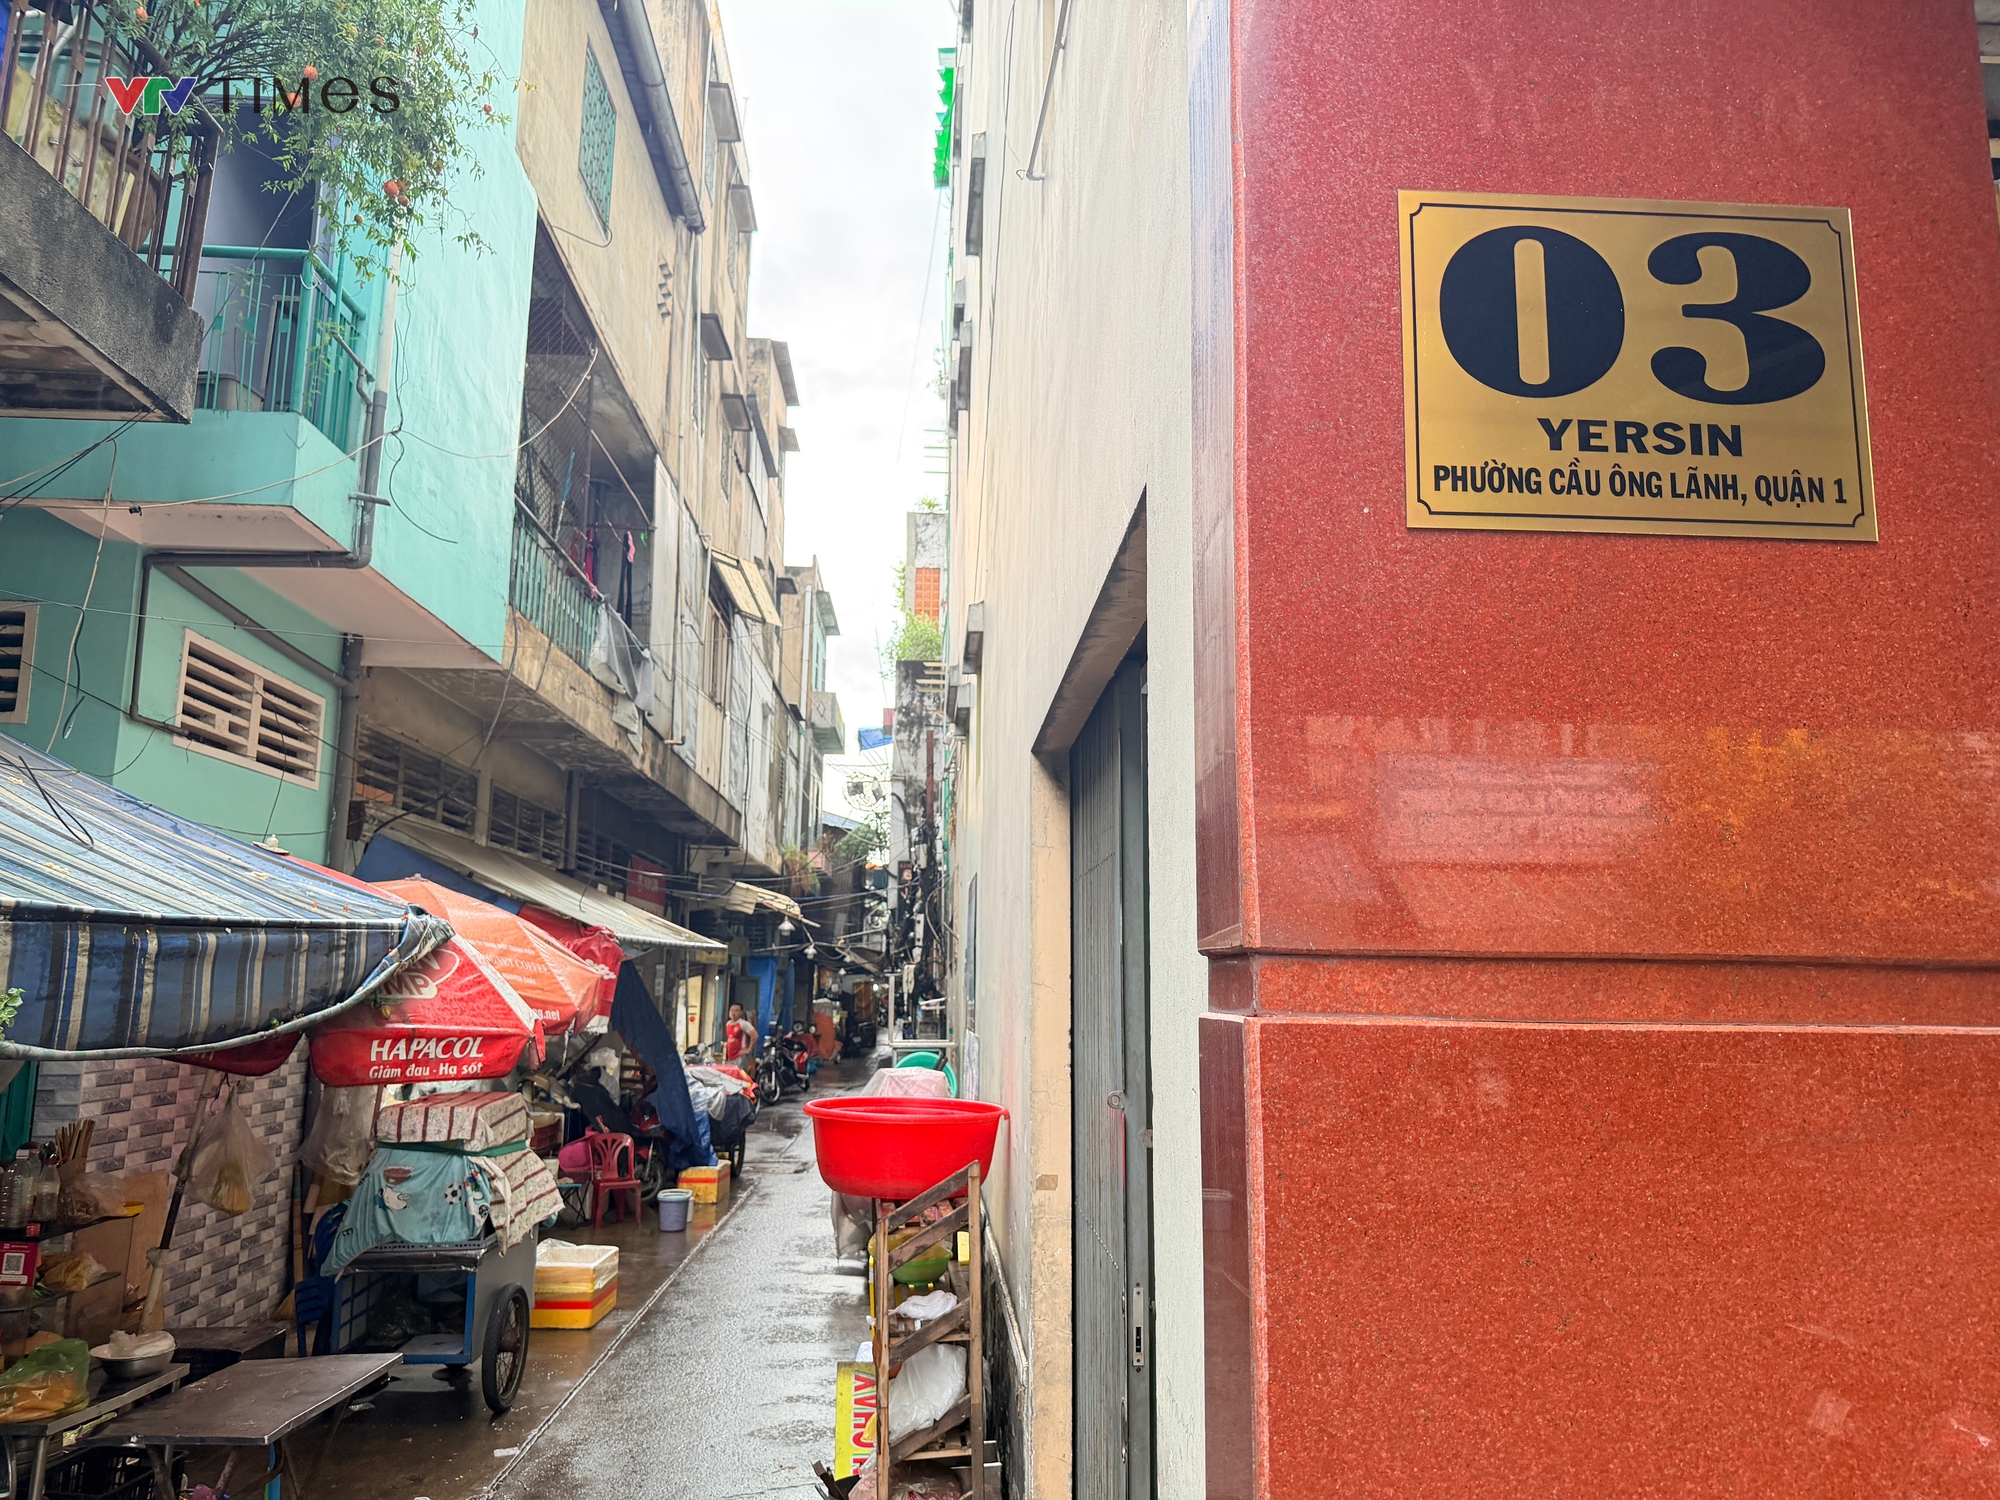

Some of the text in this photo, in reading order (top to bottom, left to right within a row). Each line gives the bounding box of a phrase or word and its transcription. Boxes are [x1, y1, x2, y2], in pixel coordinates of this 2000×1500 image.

[1439, 225, 1826, 405] 03
[1537, 418, 1742, 457] YERSIN
[1433, 457, 1847, 508] PHƯỜNG CẦU ÔNG LÃNH, QUẬN 1
[370, 1036, 484, 1062] HAPACOL
[369, 1065, 401, 1079] Giảm
[406, 1063, 430, 1077] đau
[438, 1062, 458, 1078] Hạ
[461, 1061, 484, 1075] sốt
